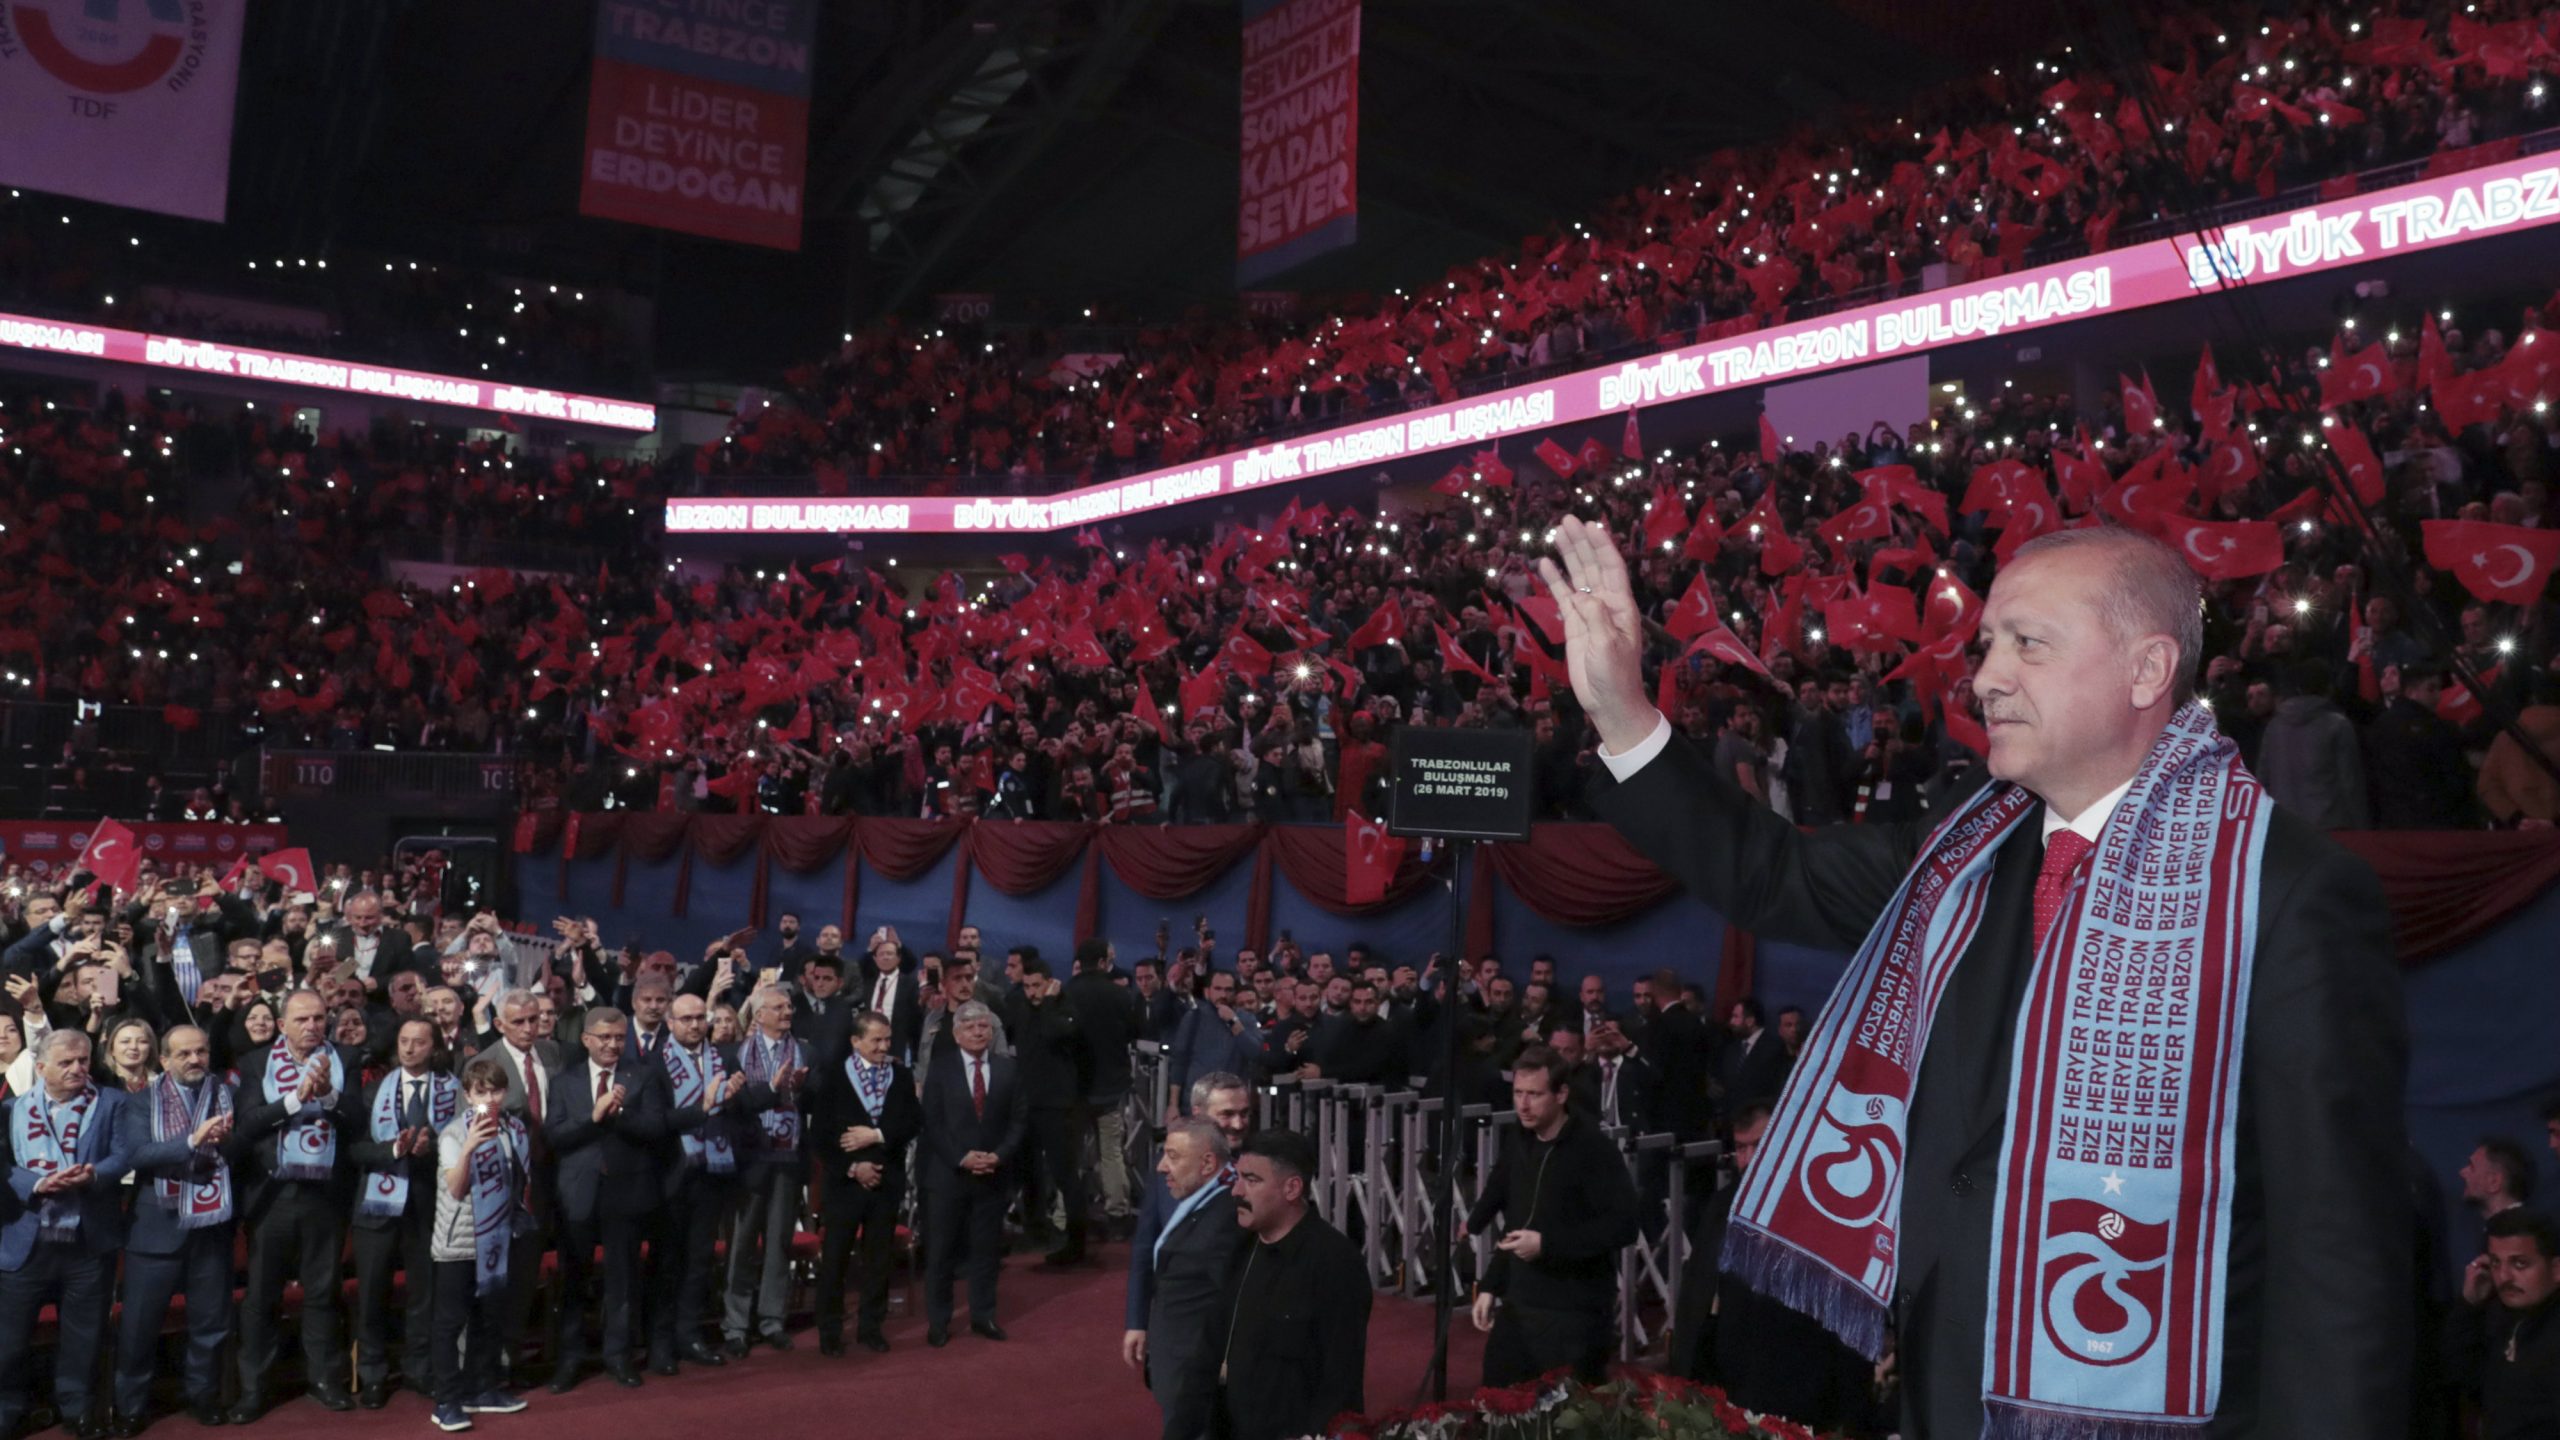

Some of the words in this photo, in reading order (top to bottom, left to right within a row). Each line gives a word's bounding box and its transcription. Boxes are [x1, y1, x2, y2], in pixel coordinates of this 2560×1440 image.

[68, 95, 118, 120] TDF
[1240, 160, 1349, 251] SEVER
[146, 338, 234, 372] BÜYÜK
[236, 353, 348, 388] TRABZON
[752, 505, 909, 532] BULUŞMASI
[954, 498, 1050, 529] BÜYÜK
[1049, 488, 1120, 526] TRABZON
[1121, 465, 1220, 512] BULUŞMASI
[1233, 444, 1302, 488] BÜYÜK
[1303, 423, 1405, 472] TRABZON
[1408, 389, 1554, 450] BULUŞMASI
[1600, 353, 1705, 410] BÜYÜK
[1708, 320, 1868, 386] TRABZON
[1876, 266, 2111, 352] BULUŞMASI
[2188, 210, 2364, 288] BÜYÜK
[298, 765, 334, 785] 110
[1410, 758, 1511, 772] TRABZONLULAR
[1413, 784, 1433, 796] (26
[1436, 785, 1472, 796] MART
[1474, 786, 1509, 800] 2019)
[1423, 771, 1496, 784] BULUŞMASI
[2102, 802, 2138, 874] HERYER
[2127, 732, 2176, 798] TRABZON
[2122, 808, 2150, 883] HERYER
[2141, 816, 2164, 887] HERYER
[2163, 821, 2185, 887] HERYER
[2186, 820, 2209, 885] HERYER
[2073, 927, 2104, 1020] TRABZON
[2096, 935, 2127, 1024] TRABZON
[2119, 940, 2149, 1026] TRABZON
[2143, 940, 2170, 1027] TRABZON
[2168, 937, 2195, 1028] TRABZON
[2063, 1025, 2089, 1109] HERYER
[2086, 1028, 2112, 1112] HERYER
[2110, 1031, 2136, 1115] HERYER
[2133, 1032, 2160, 1117] HERYER
[2158, 1034, 2185, 1118] HERYER
[2087, 1339, 2113, 1354] 1967
